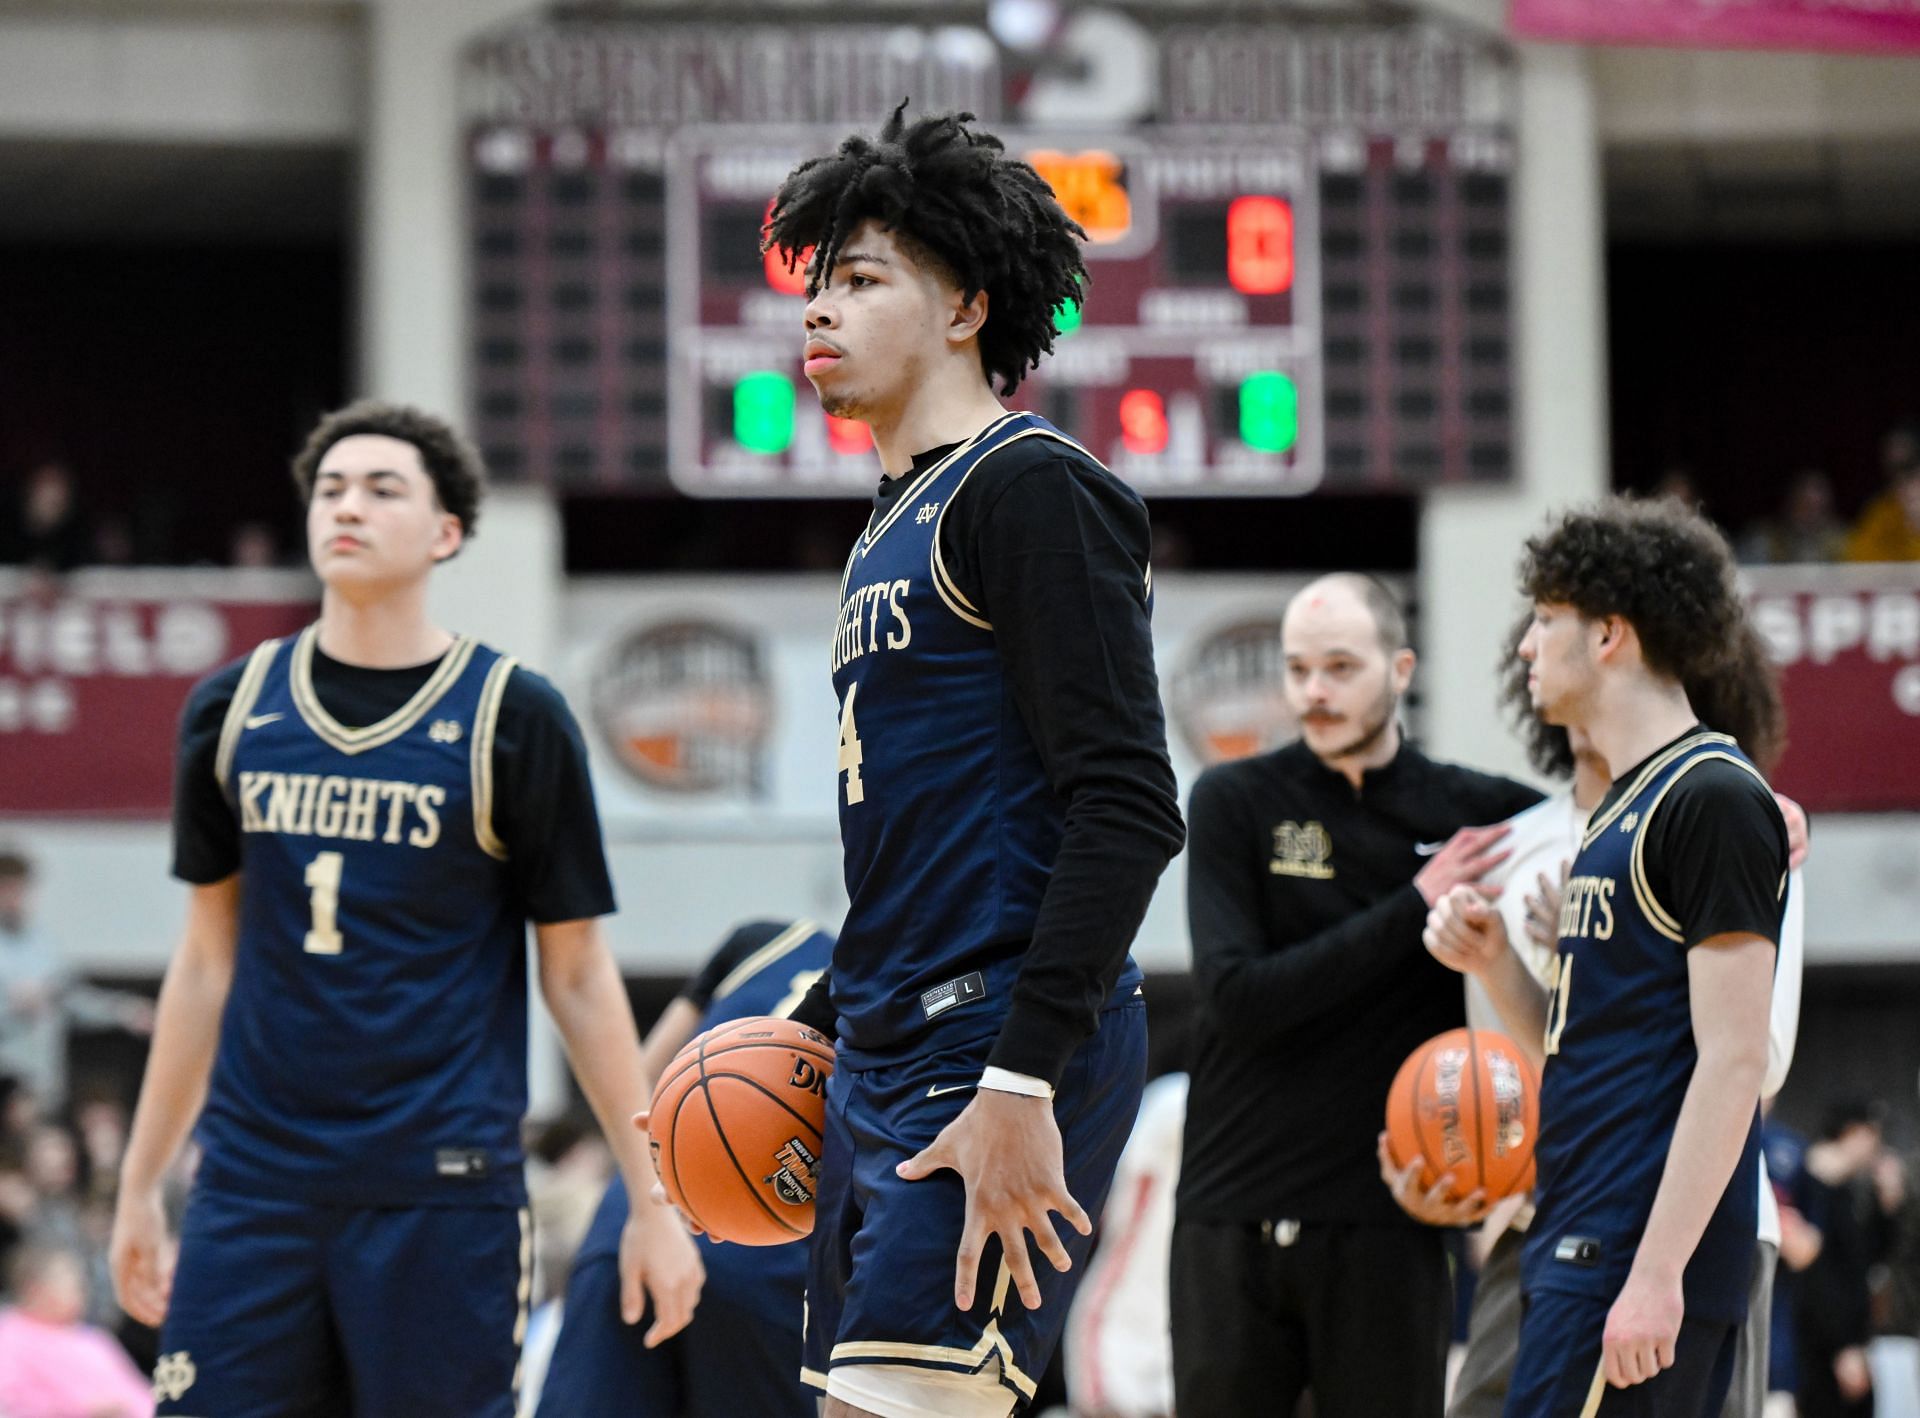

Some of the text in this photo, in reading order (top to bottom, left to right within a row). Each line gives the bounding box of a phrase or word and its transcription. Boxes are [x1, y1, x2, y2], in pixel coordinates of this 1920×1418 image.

[0, 603, 229, 677] IELD
[239, 771, 447, 849] KNIGHTS
[303, 851, 345, 955] 1
[964, 982, 974, 994] L
[791, 1139, 814, 1163] CLASSIC
[779, 1171, 810, 1203] SPALDING
